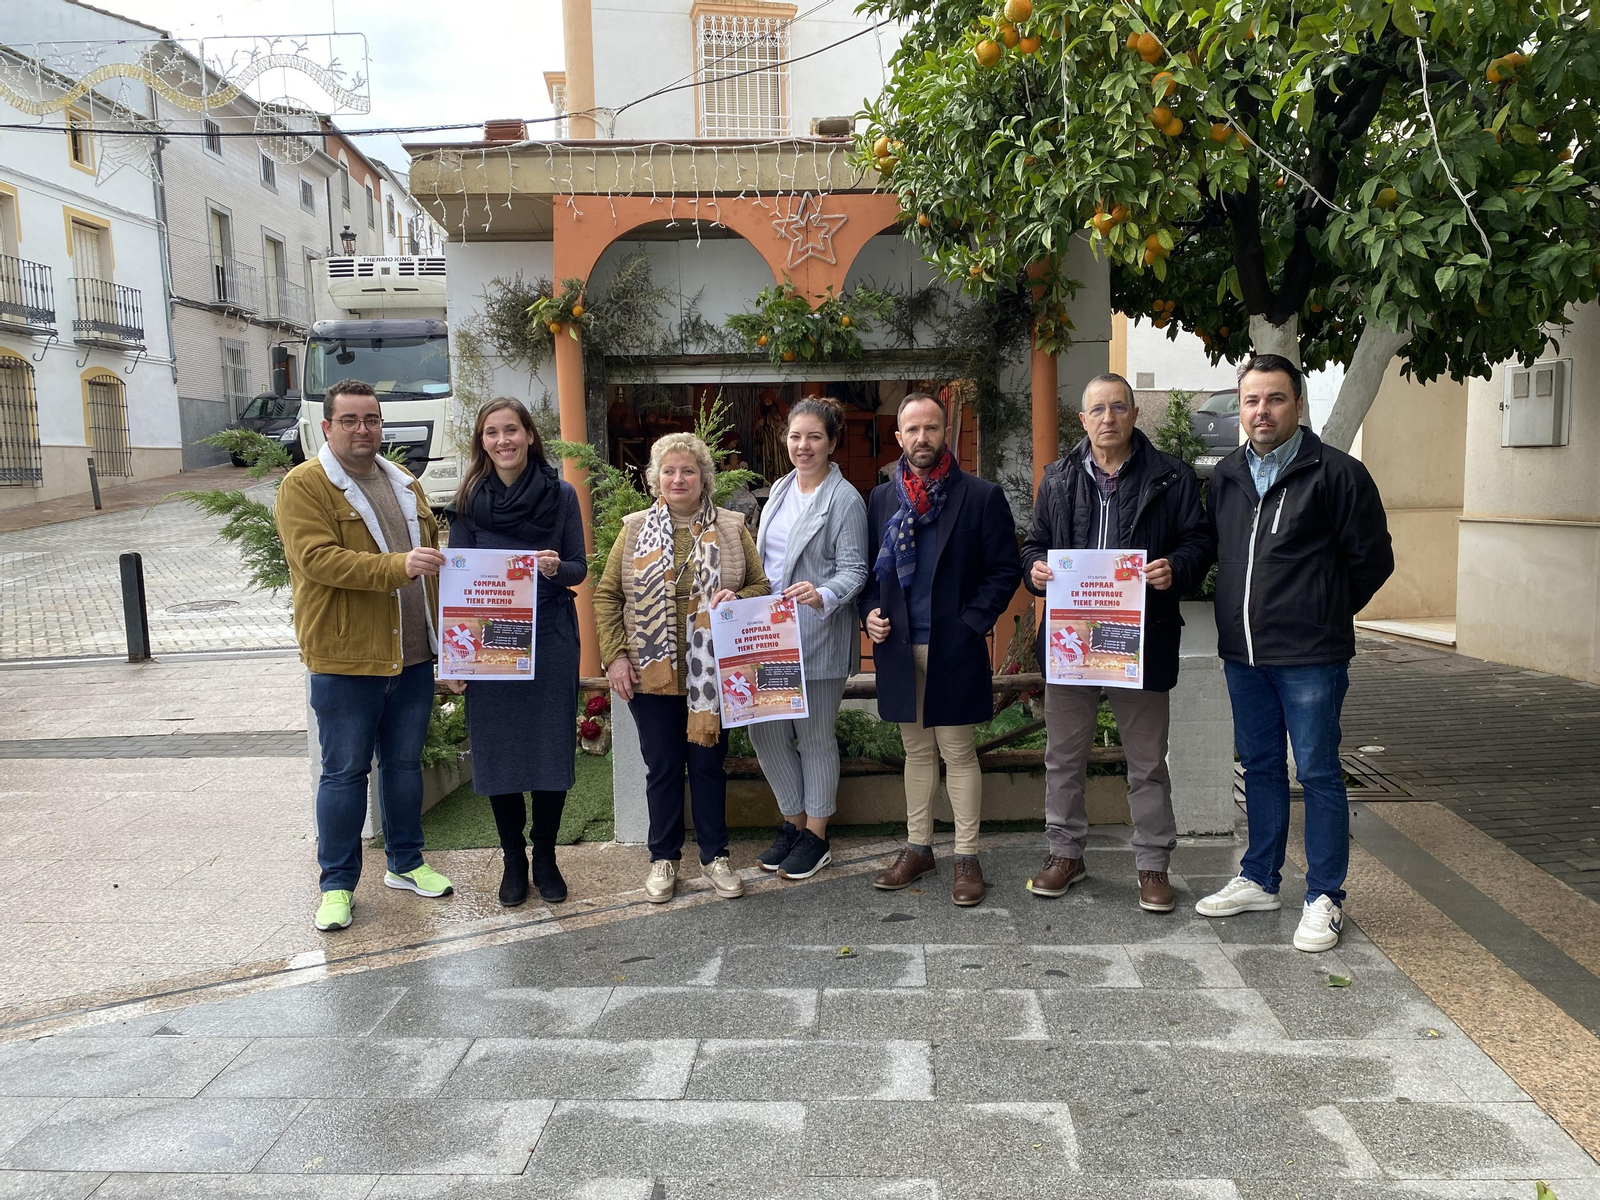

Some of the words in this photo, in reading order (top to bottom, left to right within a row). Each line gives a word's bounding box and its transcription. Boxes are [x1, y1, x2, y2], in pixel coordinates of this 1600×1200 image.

[742, 626, 771, 634] COMPRAR
[744, 633, 780, 643] MONTURQUE
[737, 644, 754, 652] TIENE
[756, 642, 779, 650] PREMIO
